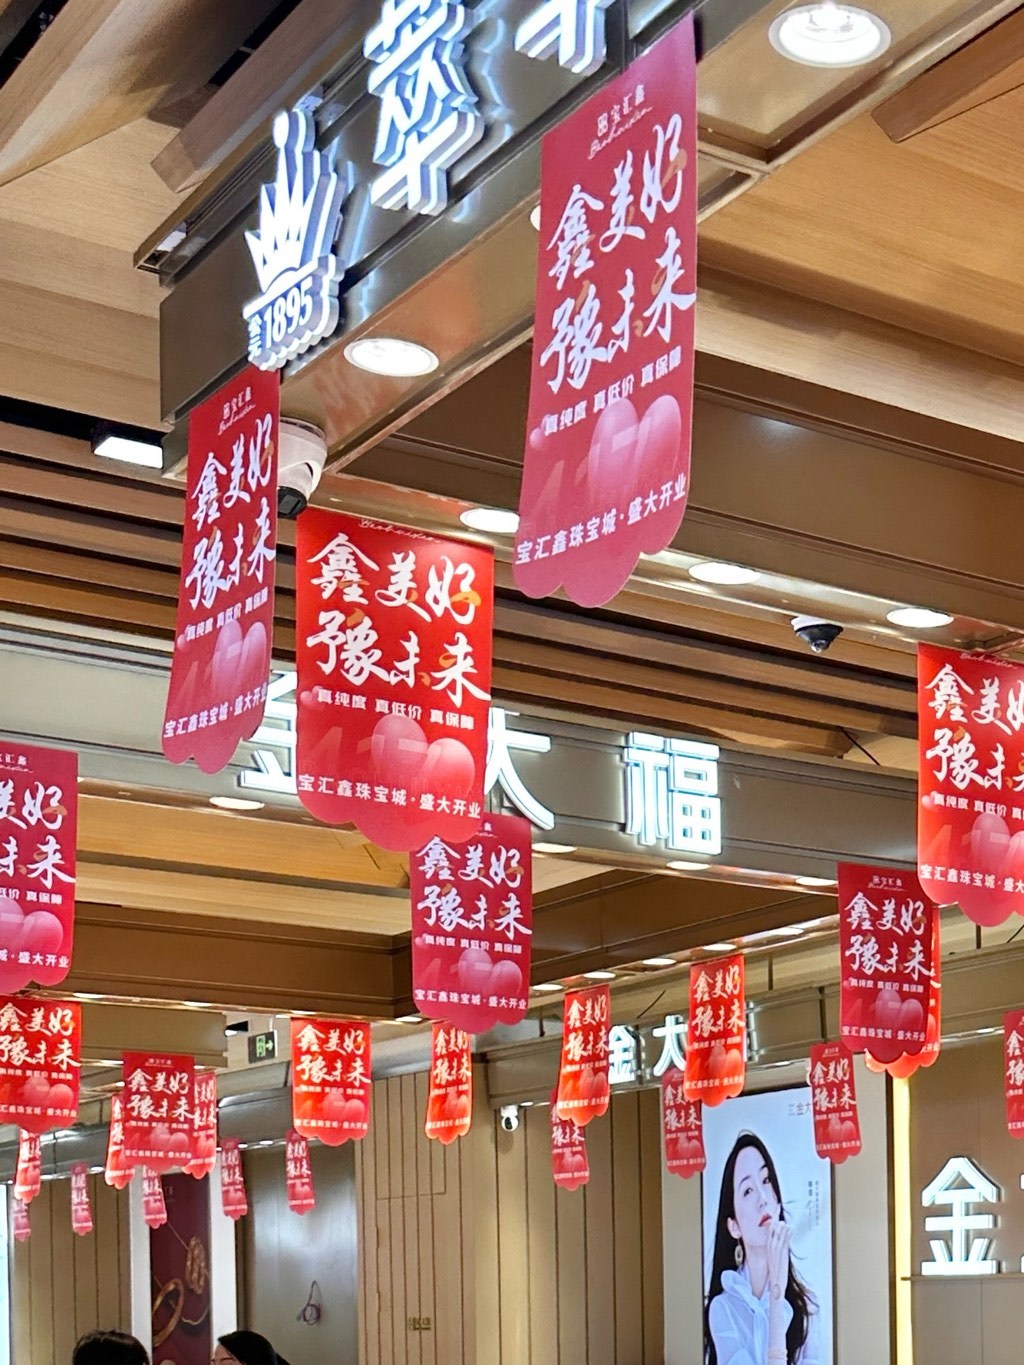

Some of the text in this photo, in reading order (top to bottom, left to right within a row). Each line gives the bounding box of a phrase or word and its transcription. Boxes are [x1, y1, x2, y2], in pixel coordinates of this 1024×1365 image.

[547, 114, 688, 290] 鑫美好
[264, 276, 313, 350] 1895
[540, 226, 697, 394] 豫未来
[191, 413, 275, 531] 鑫美好
[185, 497, 275, 610] 豫未来
[515, 472, 687, 565] 宝汇鑫珠宝城·盛大开业
[307, 532, 482, 625] 鑫美好
[306, 609, 491, 709] 豫未来
[317, 689, 475, 730] 真纯度 真低价 真保障
[298, 774, 481, 819] 宝汇鑫珠宝城·盛大开业
[416, 836, 525, 888] 鑫美好
[417, 885, 532, 941] 豫未来
[844, 892, 927, 936] 鑫美好
[845, 935, 933, 981] 豫未来
